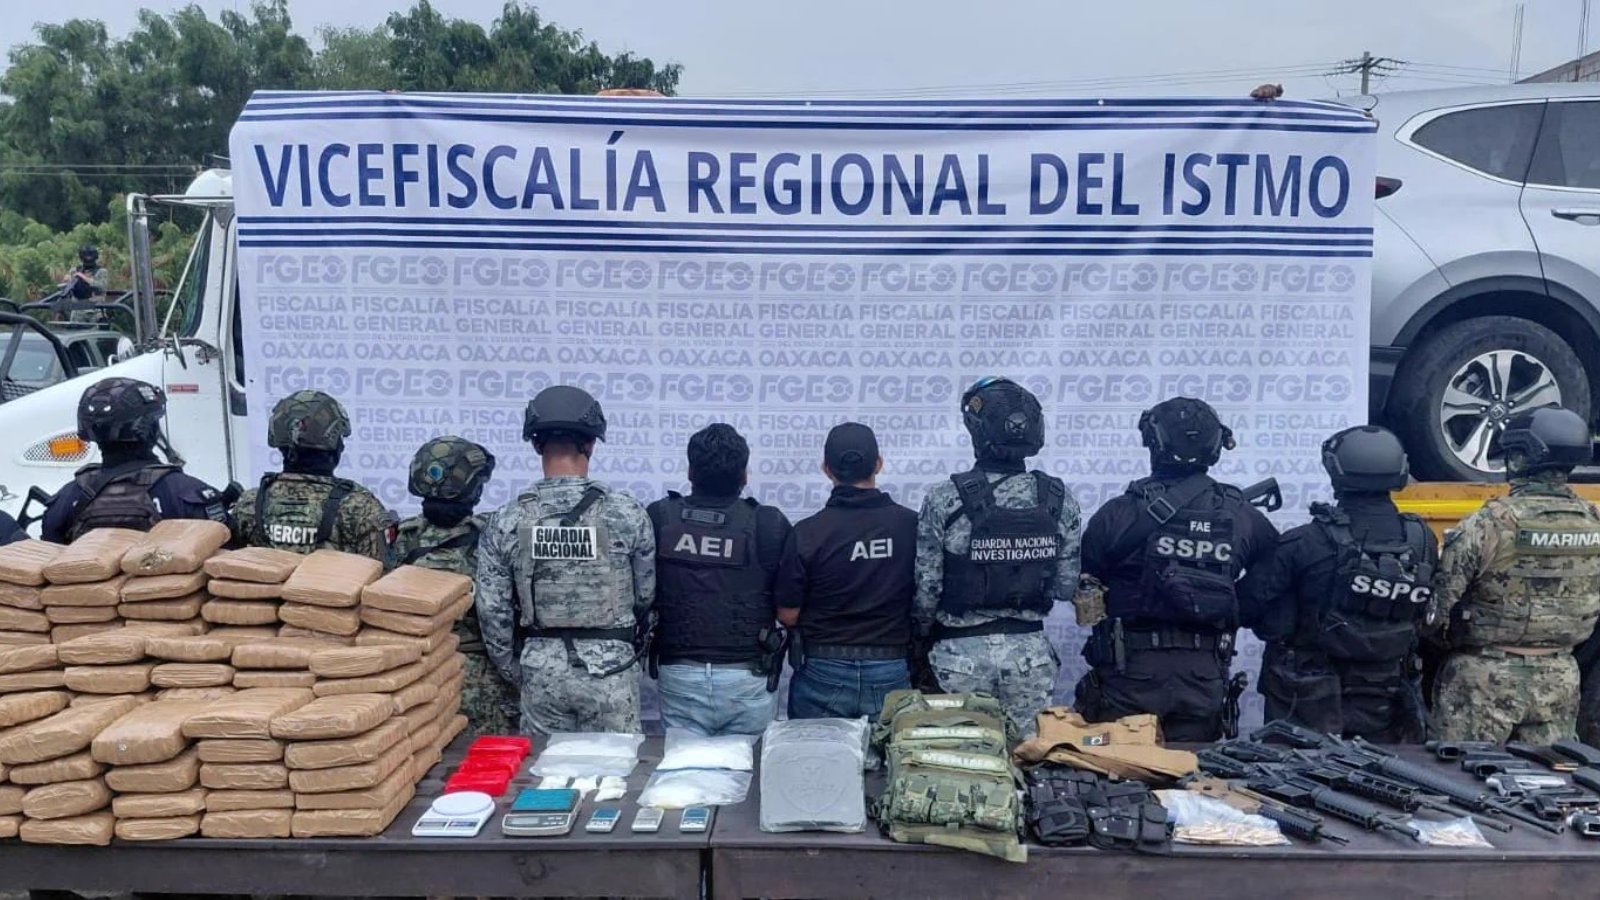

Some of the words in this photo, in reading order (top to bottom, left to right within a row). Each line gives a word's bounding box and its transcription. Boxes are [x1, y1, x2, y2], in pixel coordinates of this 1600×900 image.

[255, 131, 665, 212] VICEFISCALÍA
[688, 151, 1006, 215] REGIONAL
[1029, 152, 1139, 216] DEL
[1162, 152, 1350, 218] ISTMO
[260, 315, 349, 331] GENERAL
[353, 316, 451, 333] GENERAL
[455, 318, 552, 335] GENERAL
[557, 320, 653, 337] GENERAL
[658, 322, 754, 338] GENERAL
[759, 323, 854, 339] GENERAL
[860, 323, 956, 339] GENERAL
[960, 323, 1055, 339] GENERAL
[1061, 323, 1155, 339] GENERAL
[1160, 323, 1255, 339] GENERAL
[1260, 324, 1354, 340] GENERAL
[261, 341, 350, 359] OAXACA
[354, 343, 451, 361] OAXACA
[456, 344, 552, 363] OAXACA
[557, 346, 653, 365] OAXACA
[658, 348, 754, 366] OAXACA
[759, 349, 854, 367] OAXACA
[859, 350, 953, 367] OAXACA
[959, 350, 1053, 367] OAXACA
[1059, 350, 1152, 367] OAXACA
[1158, 349, 1253, 367] OAXACA
[1258, 350, 1351, 367] OAXACA
[1053, 458, 1149, 475] OAXACA
[1190, 520, 1211, 533] FAE
[536, 528, 591, 543] GUARDIA
[971, 538, 1012, 549] GUARDIA
[1015, 536, 1057, 548] NACIONAL
[1531, 533, 1600, 546] MARINA
[534, 543, 594, 558] NACIONAL
[674, 533, 733, 558] AEI
[850, 538, 893, 561] AEI
[971, 547, 1056, 561] INVESTIGACION
[1156, 536, 1232, 561] SSPC
[1351, 575, 1431, 603] SSPC
